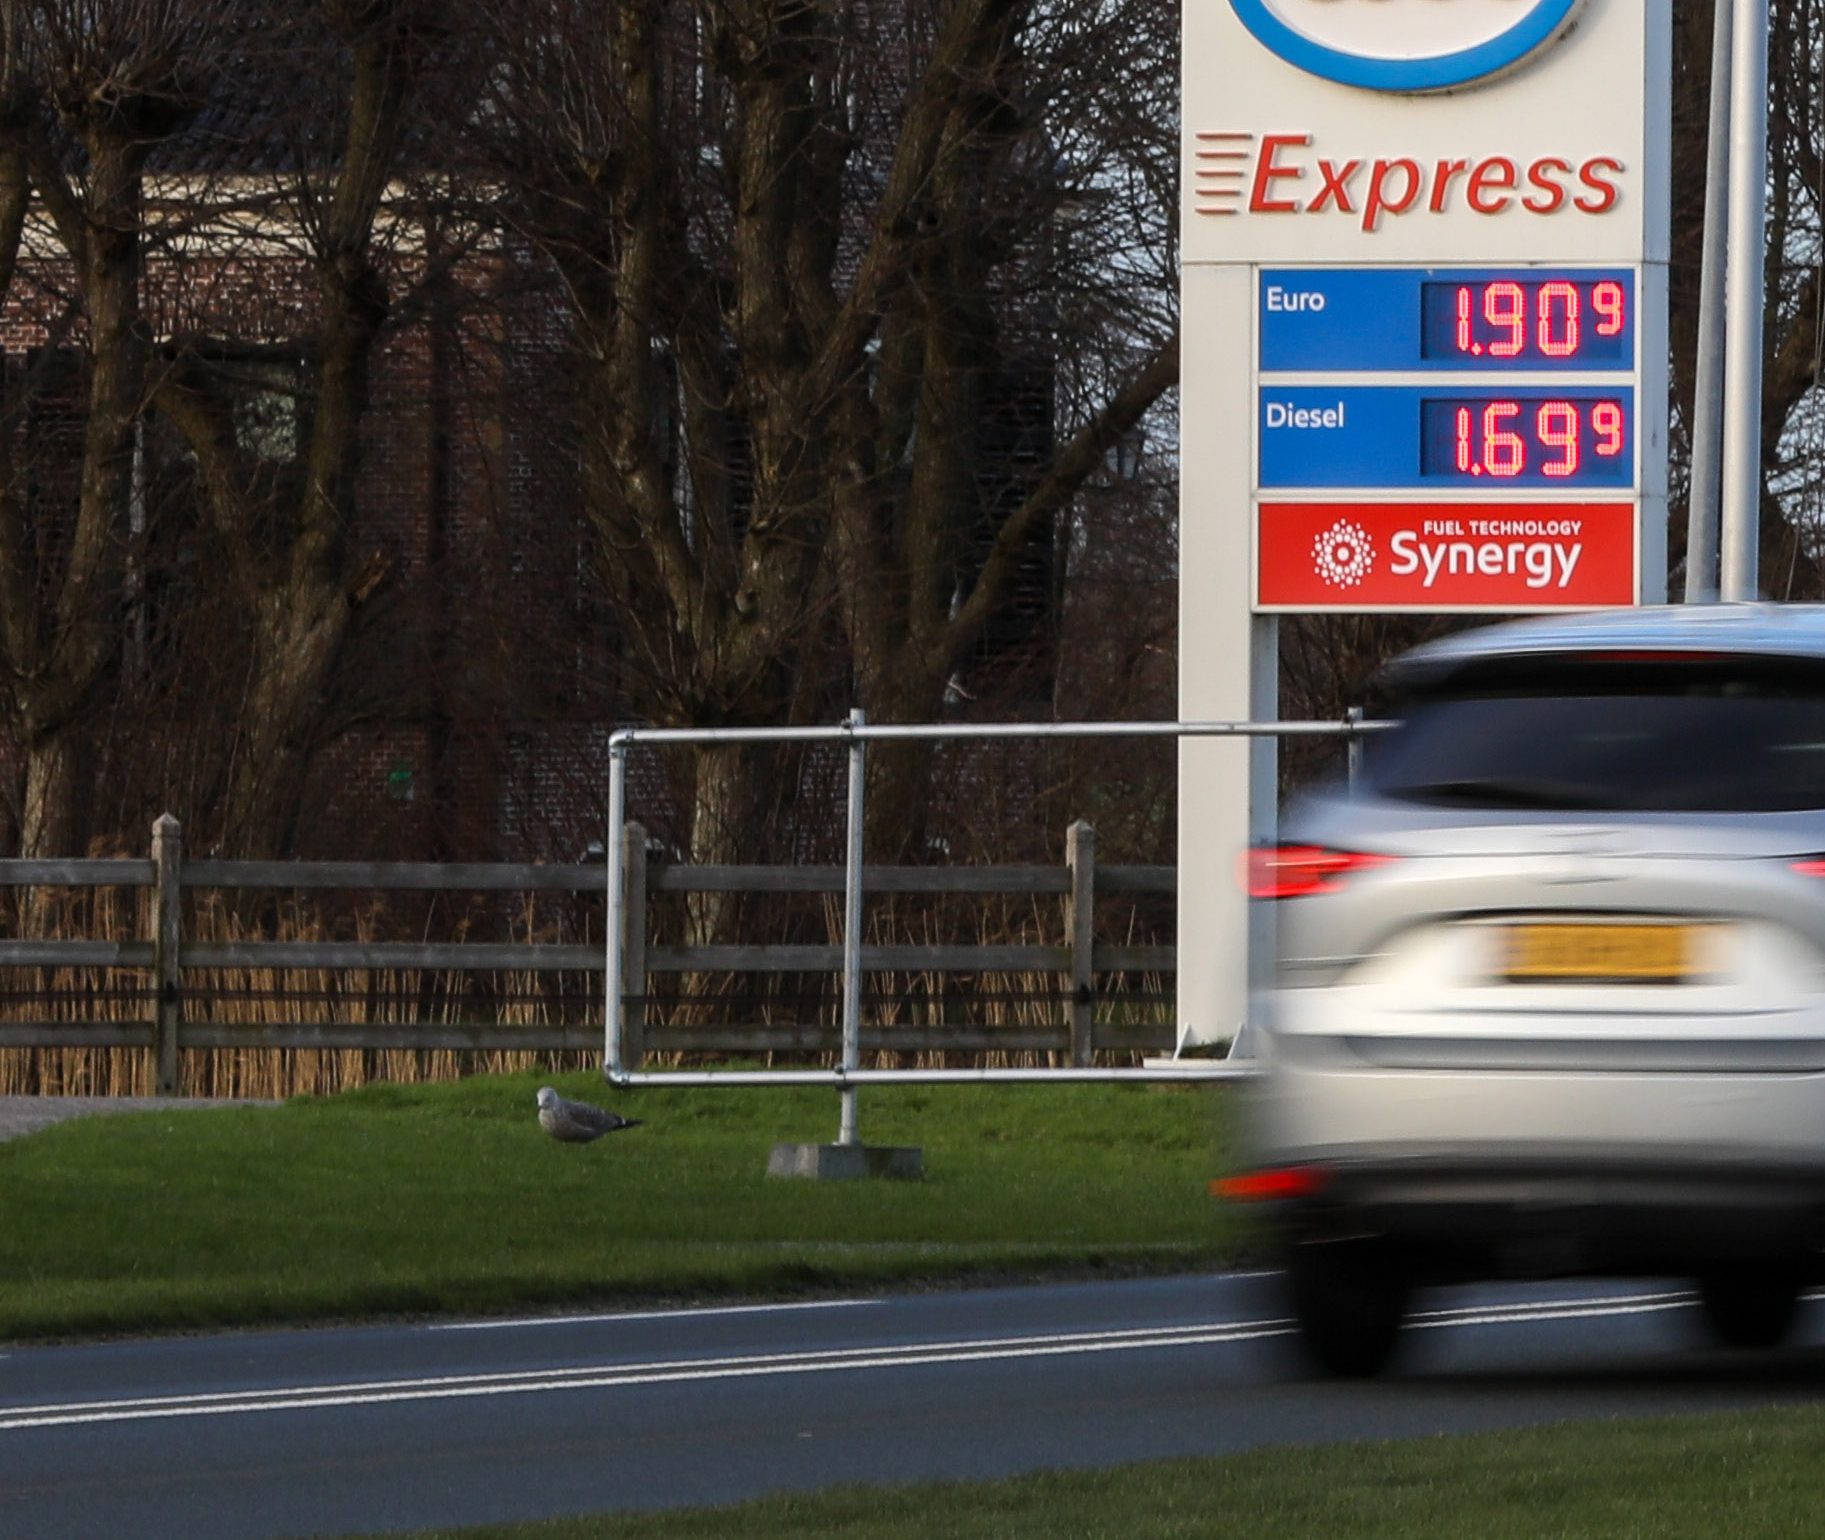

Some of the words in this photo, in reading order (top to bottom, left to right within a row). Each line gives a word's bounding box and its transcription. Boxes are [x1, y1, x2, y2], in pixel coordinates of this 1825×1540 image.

[1249, 134, 1623, 232] Express
[1266, 285, 1326, 313] Euro
[1265, 400, 1345, 430] Diesel
[1423, 520, 1465, 537] FUEL
[1468, 519, 1582, 537] TECHNOLOGY
[1389, 530, 1583, 589] Synergy
